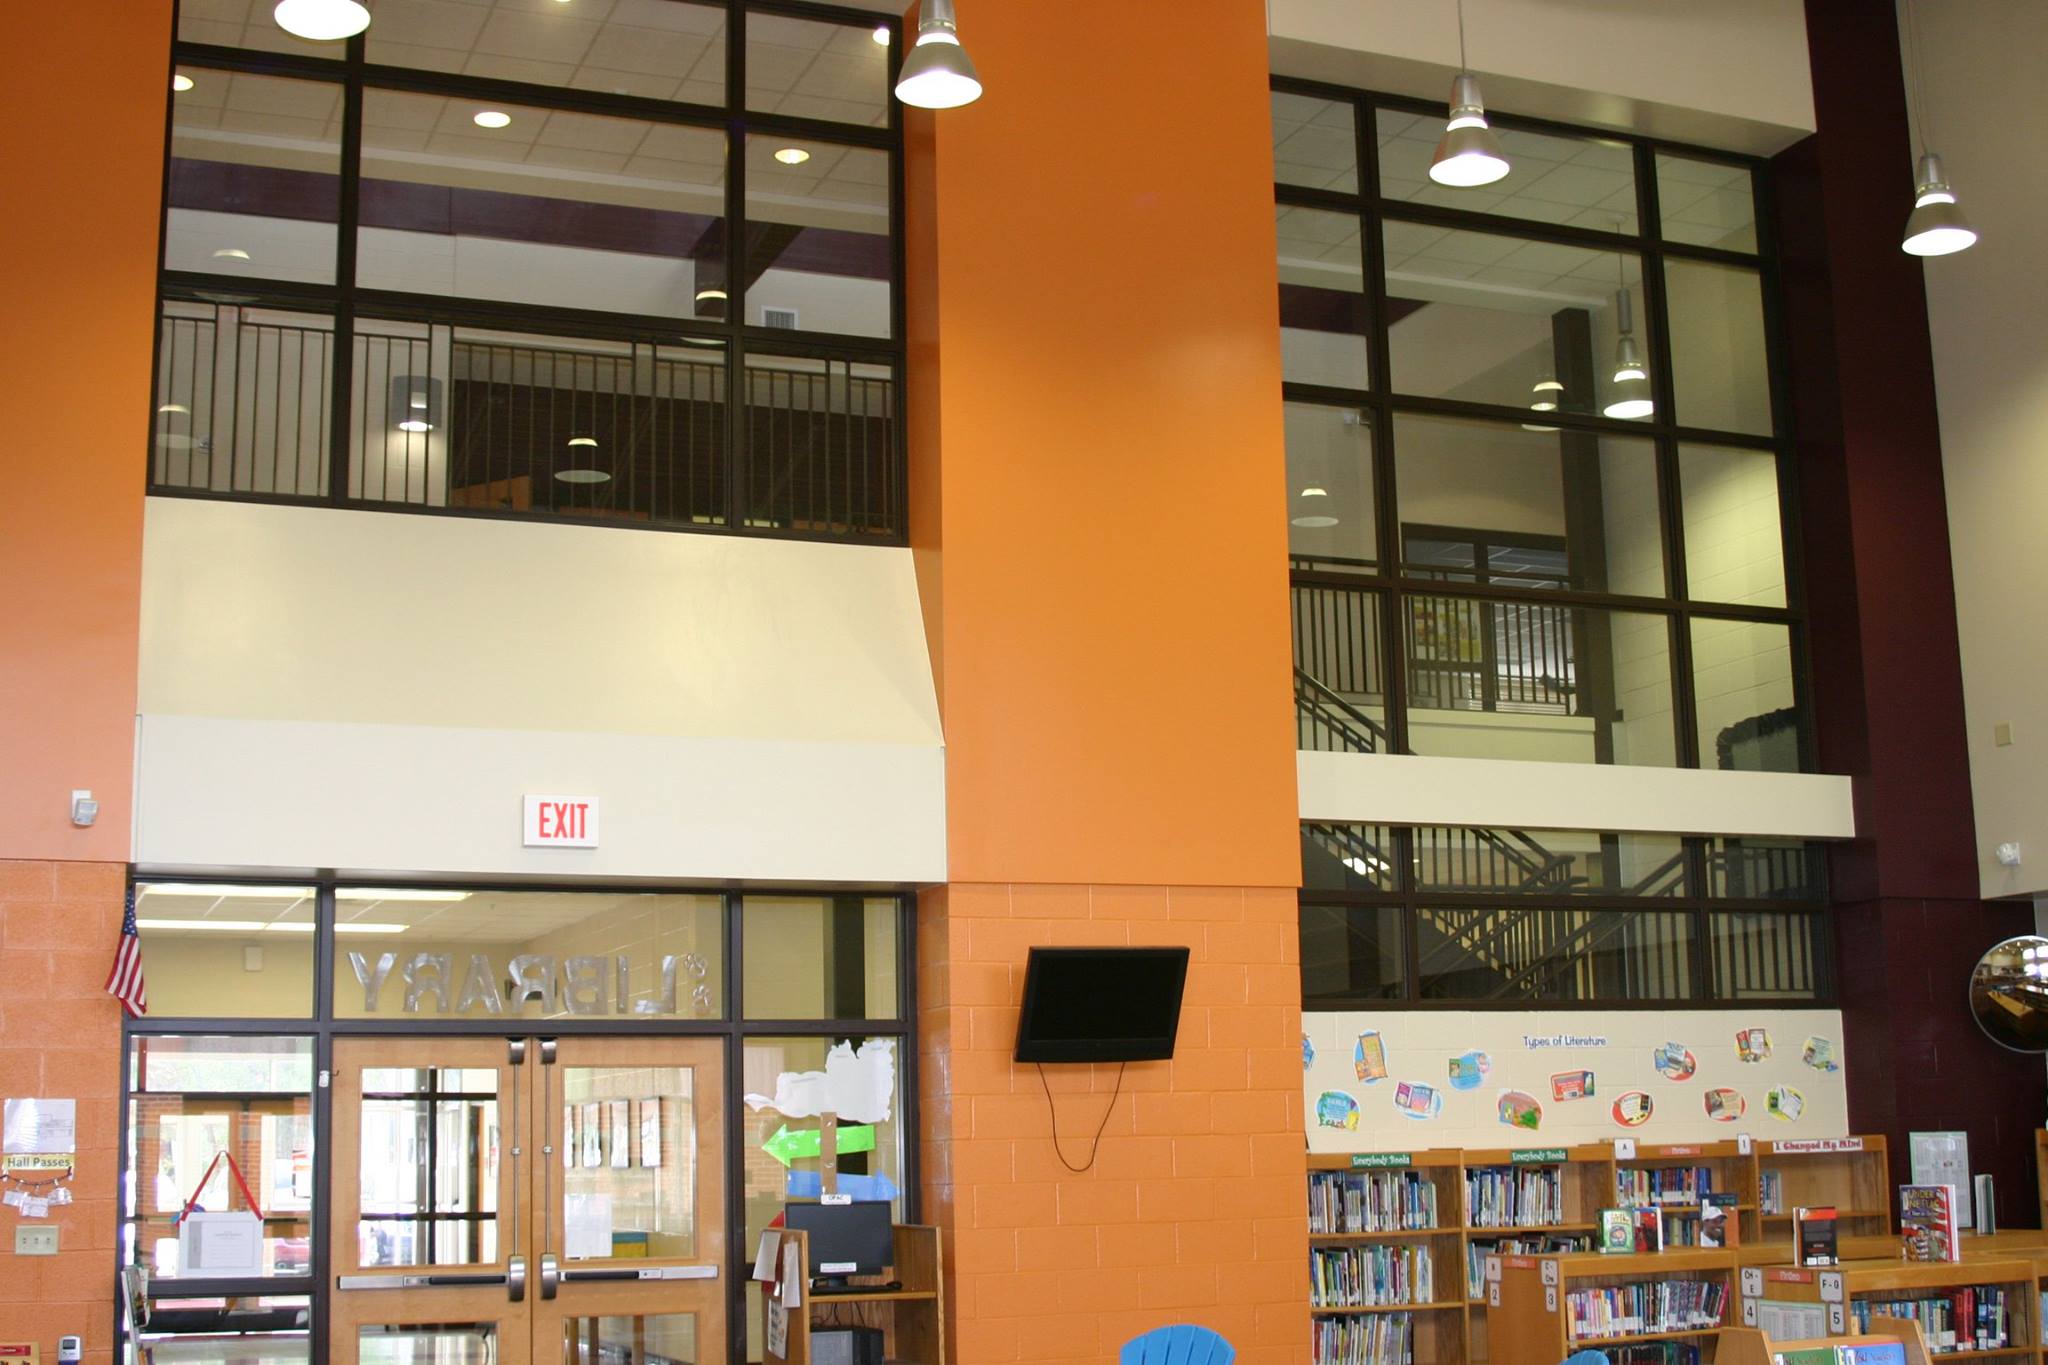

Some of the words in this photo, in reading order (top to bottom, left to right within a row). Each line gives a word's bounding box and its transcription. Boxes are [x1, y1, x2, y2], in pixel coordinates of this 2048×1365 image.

[539, 802, 589, 839] EXIT
[1523, 1036, 1550, 1050] Types
[1552, 1035, 1563, 1047] of
[1564, 1035, 1607, 1047] Literature
[7, 1157, 30, 1167] Hall
[33, 1157, 71, 1167] Passes
[1491, 1288, 1498, 1300] 2
[1548, 1293, 1555, 1305] 3
[1746, 1305, 1753, 1318] 4
[1833, 1312, 1840, 1325] 5
